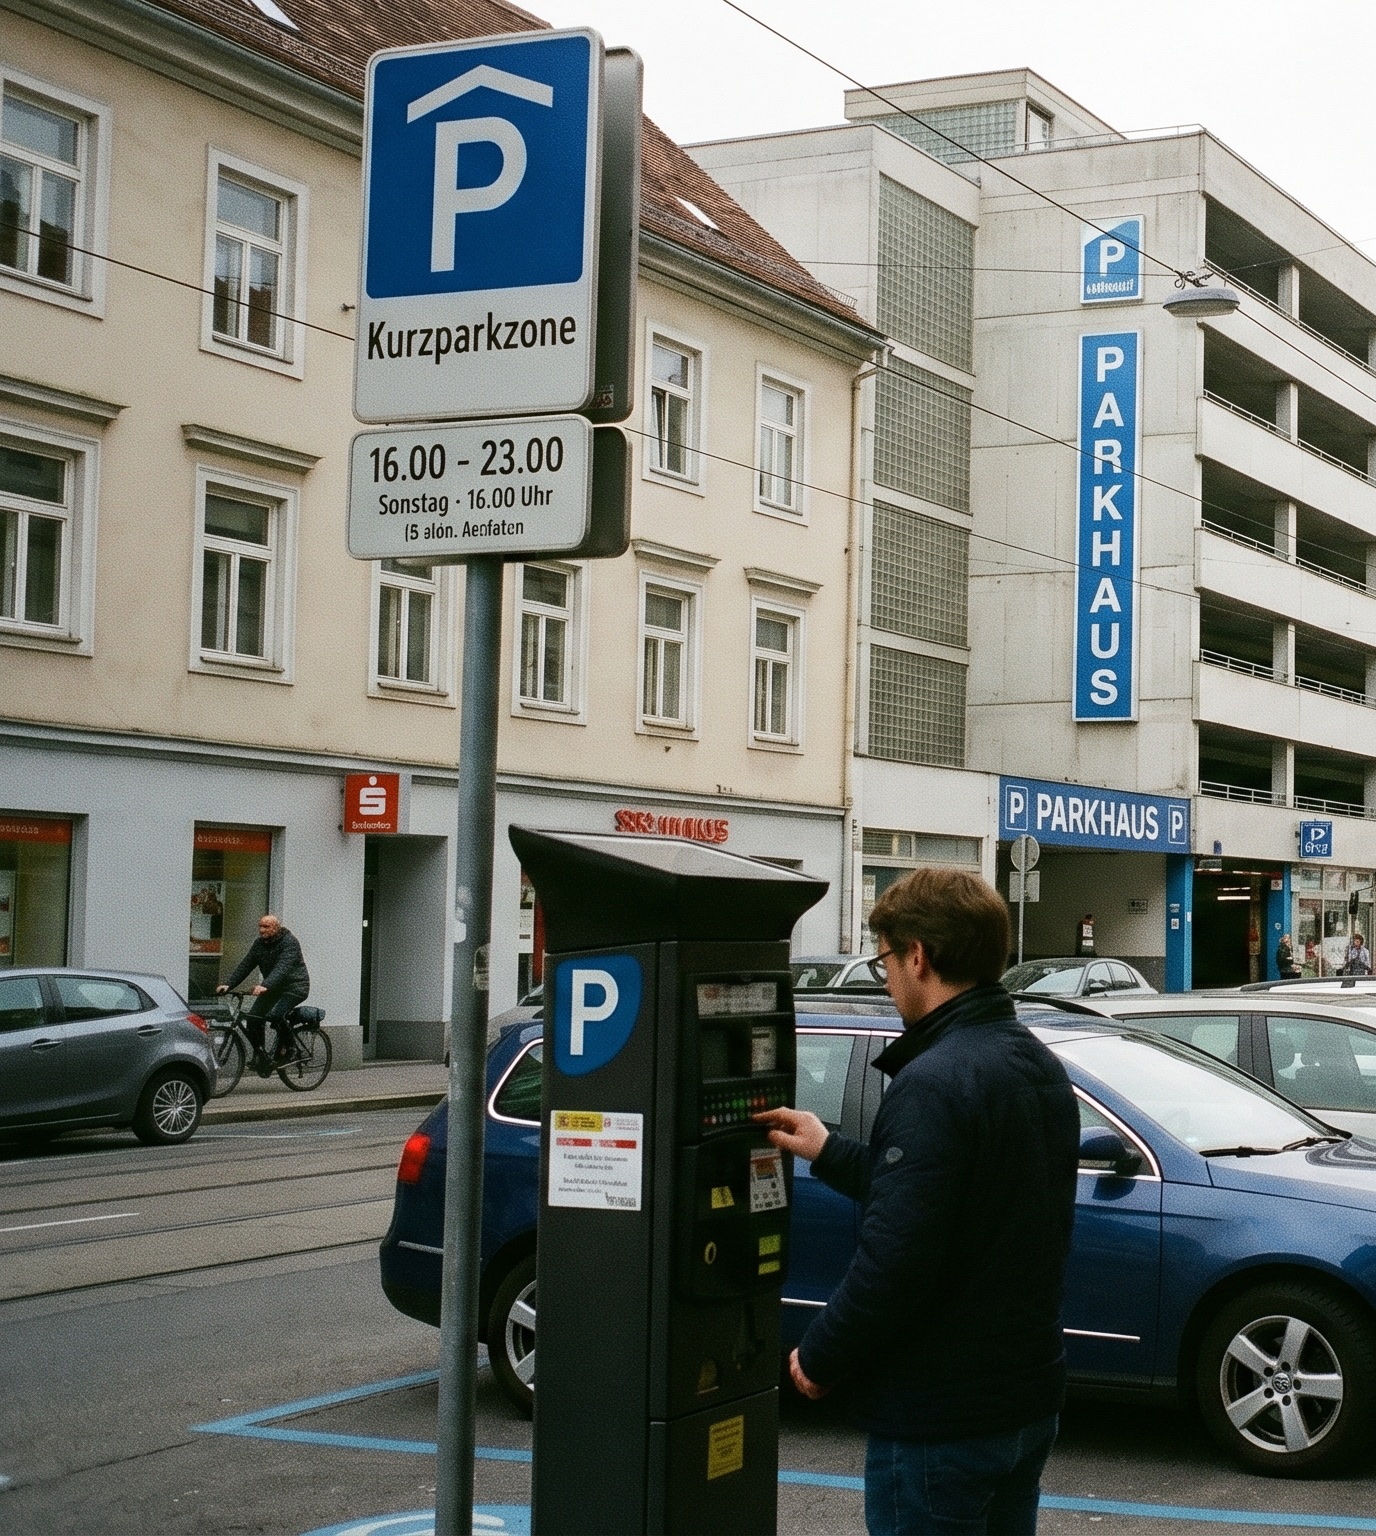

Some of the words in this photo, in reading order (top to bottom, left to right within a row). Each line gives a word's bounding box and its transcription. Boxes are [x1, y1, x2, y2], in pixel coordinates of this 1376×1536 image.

[430, 116, 528, 273] P
[1099, 239, 1126, 277] P
[367, 312, 577, 364] Kurzparkzone
[369, 443, 446, 483] 16.00
[480, 436, 564, 476] 23.00
[378, 493, 449, 517] Sonstag
[467, 487, 516, 510] 16.00
[521, 485, 554, 507] Uhr
[1089, 345, 1126, 707] PARKHAUS
[1009, 791, 1025, 824] P
[1036, 792, 1159, 841] PARKHAUS
[1171, 810, 1184, 839] P
[569, 969, 619, 1056] P
